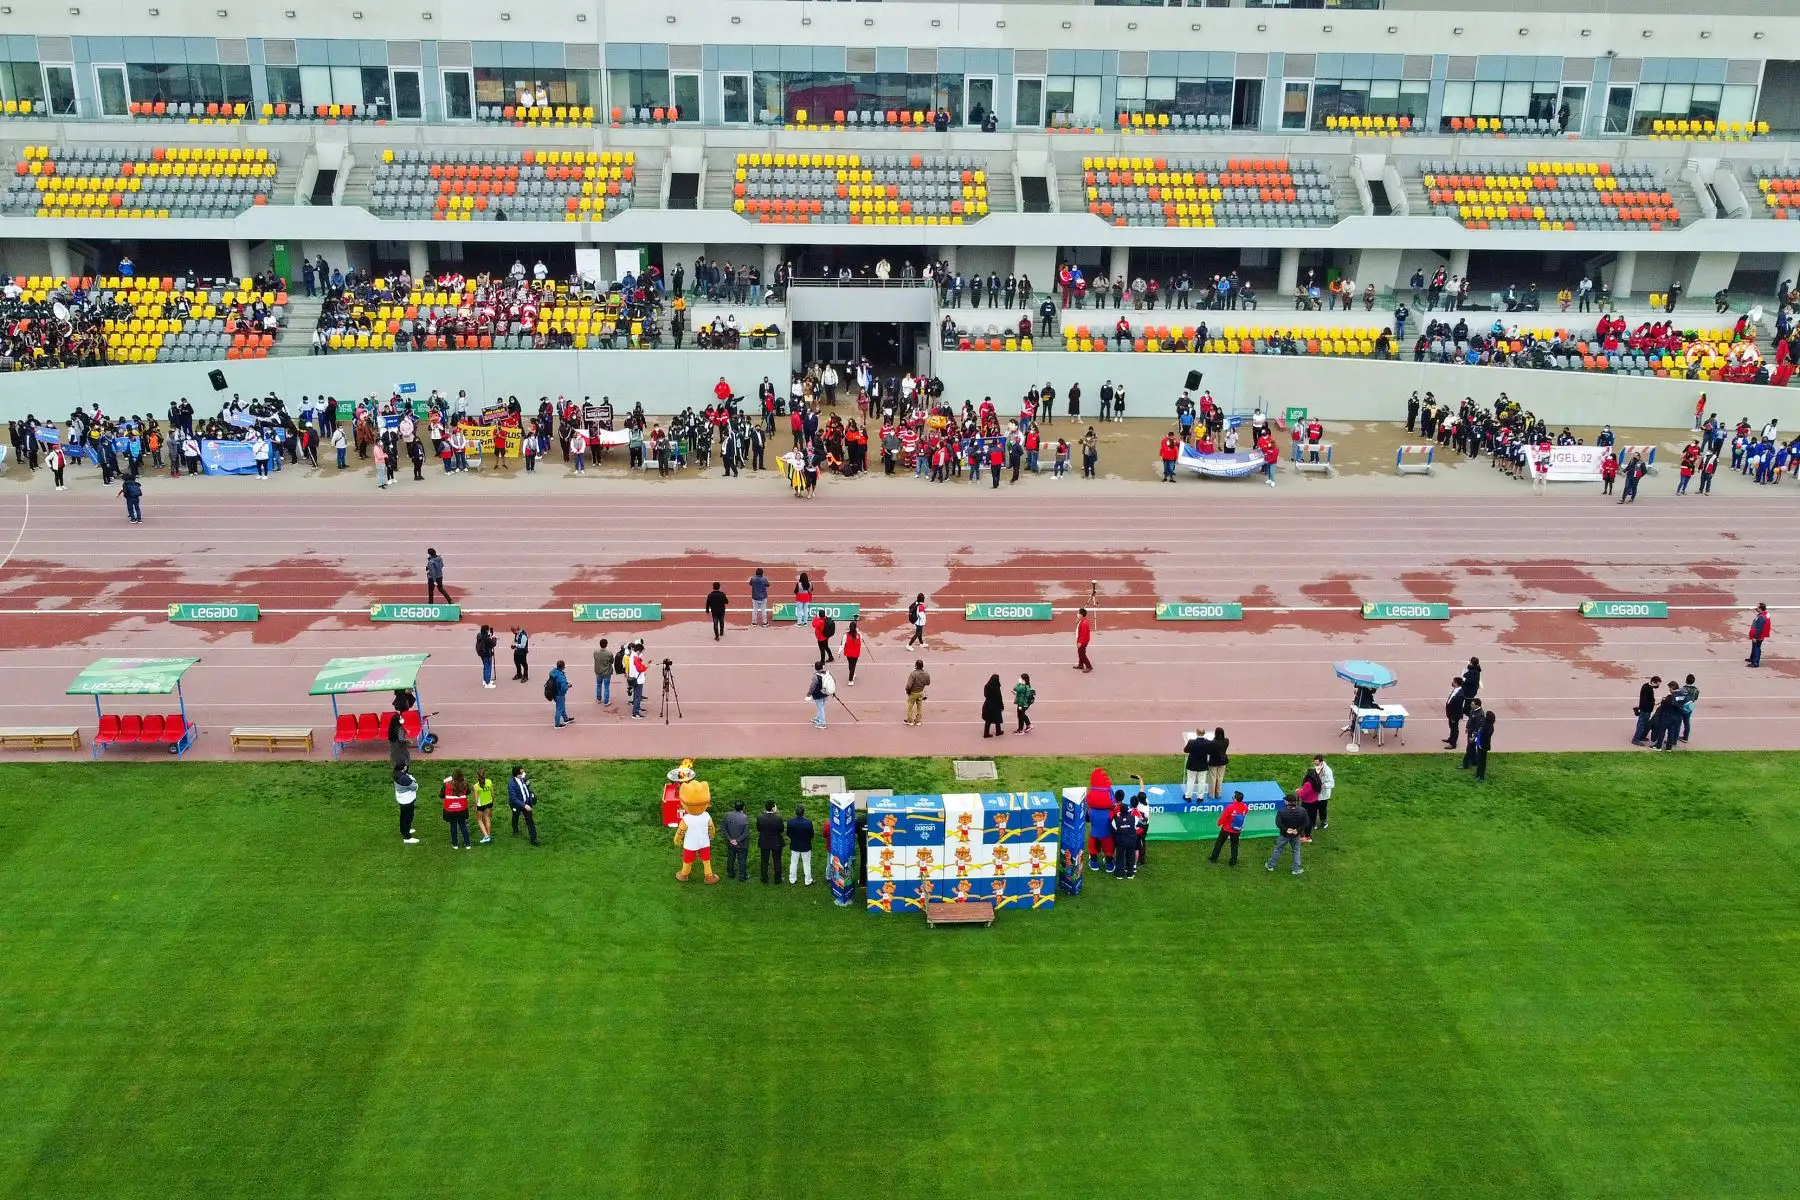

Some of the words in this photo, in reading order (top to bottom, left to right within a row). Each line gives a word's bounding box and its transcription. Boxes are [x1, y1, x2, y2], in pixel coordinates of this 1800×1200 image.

[471, 429, 491, 437] JOSE
[191, 607, 239, 618] LEGADO
[393, 607, 441, 618] LEGADO
[596, 607, 642, 619] LEGADO
[987, 606, 1033, 617] LEGADO
[1178, 606, 1223, 617] LEGADO
[1386, 606, 1431, 617] LEGADO
[1605, 604, 1649, 615] LEGADO
[1247, 802, 1276, 811] EGADO
